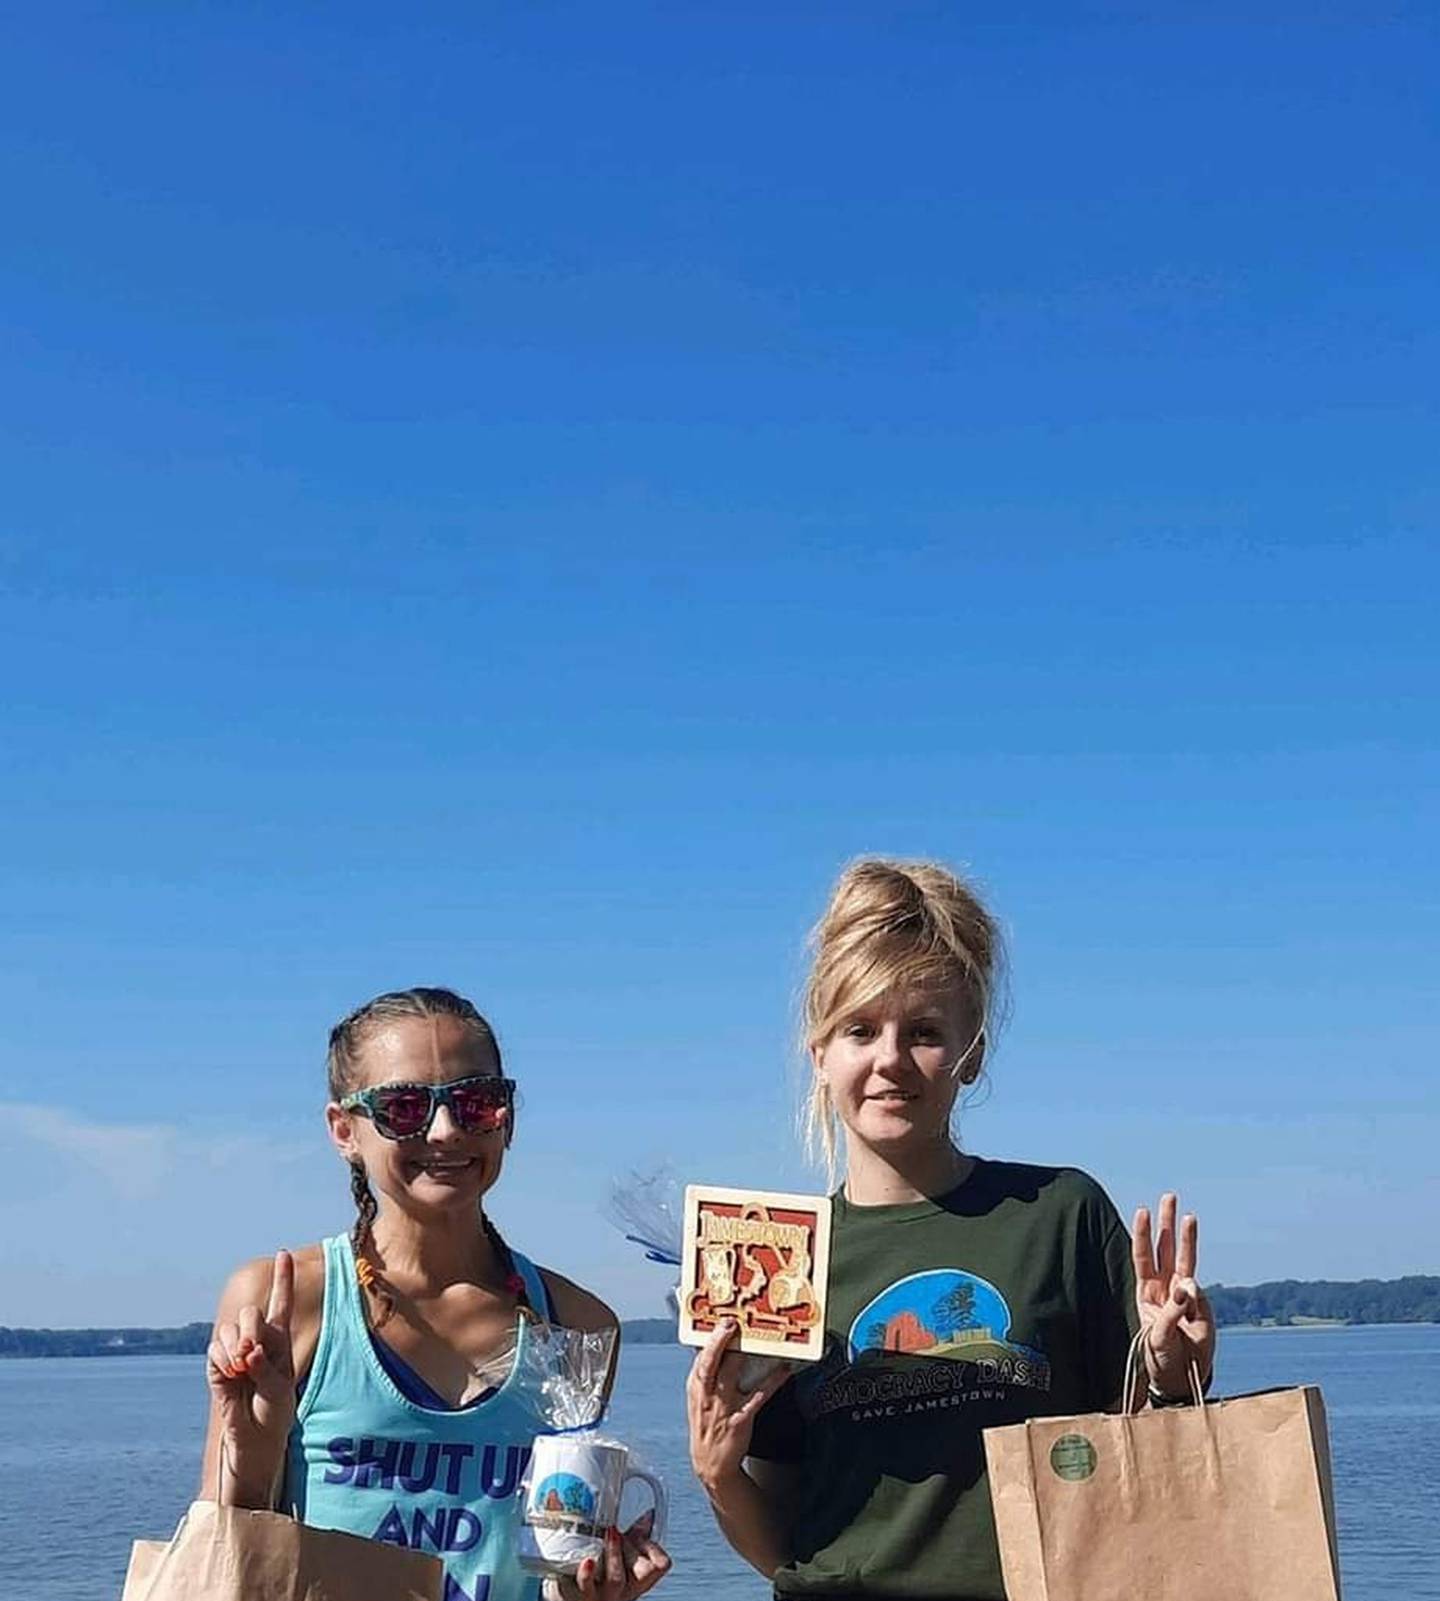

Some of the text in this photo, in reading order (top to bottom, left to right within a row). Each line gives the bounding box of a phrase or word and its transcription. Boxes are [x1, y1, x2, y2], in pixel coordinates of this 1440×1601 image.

[852, 1391, 1005, 1420] SAVE JAMESTOWN
[323, 1437, 473, 1495] SHUT
[373, 1504, 482, 1552] AND
